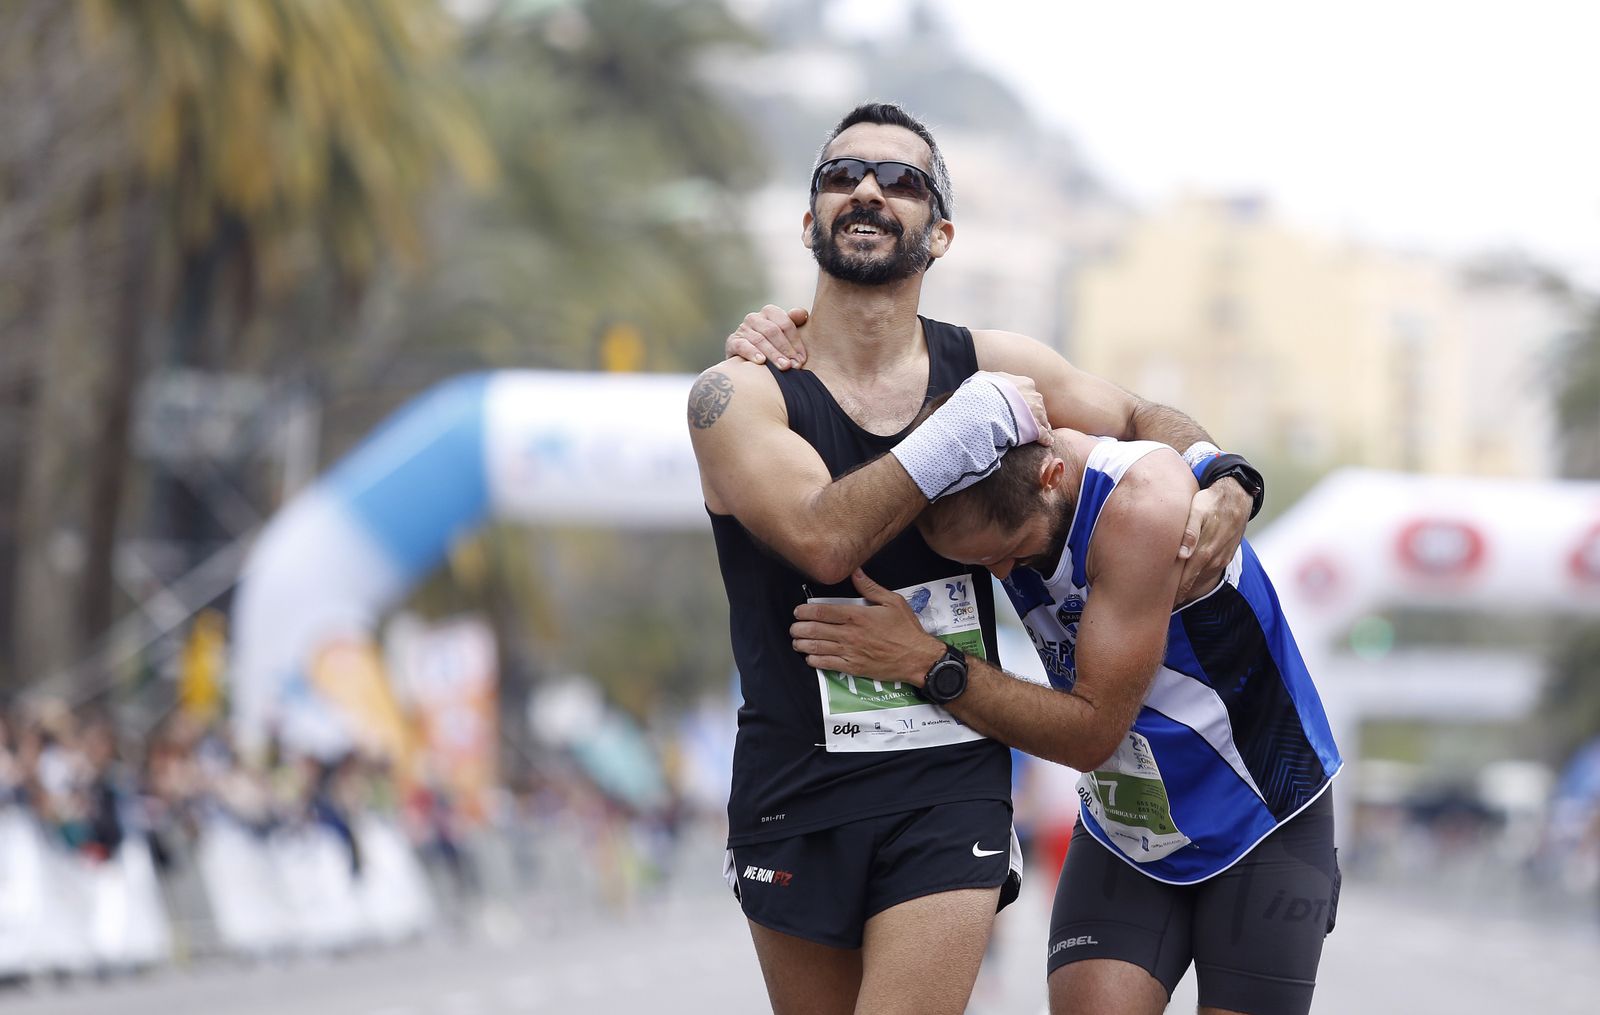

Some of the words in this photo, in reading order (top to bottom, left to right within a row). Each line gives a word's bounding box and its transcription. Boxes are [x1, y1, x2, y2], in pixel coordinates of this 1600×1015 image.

[832, 722, 861, 738] edp
[761, 813, 786, 823] DRI-FIT
[743, 864, 759, 881] WE
[755, 867, 776, 884] RUN
[1048, 935, 1099, 959] LURBEL
